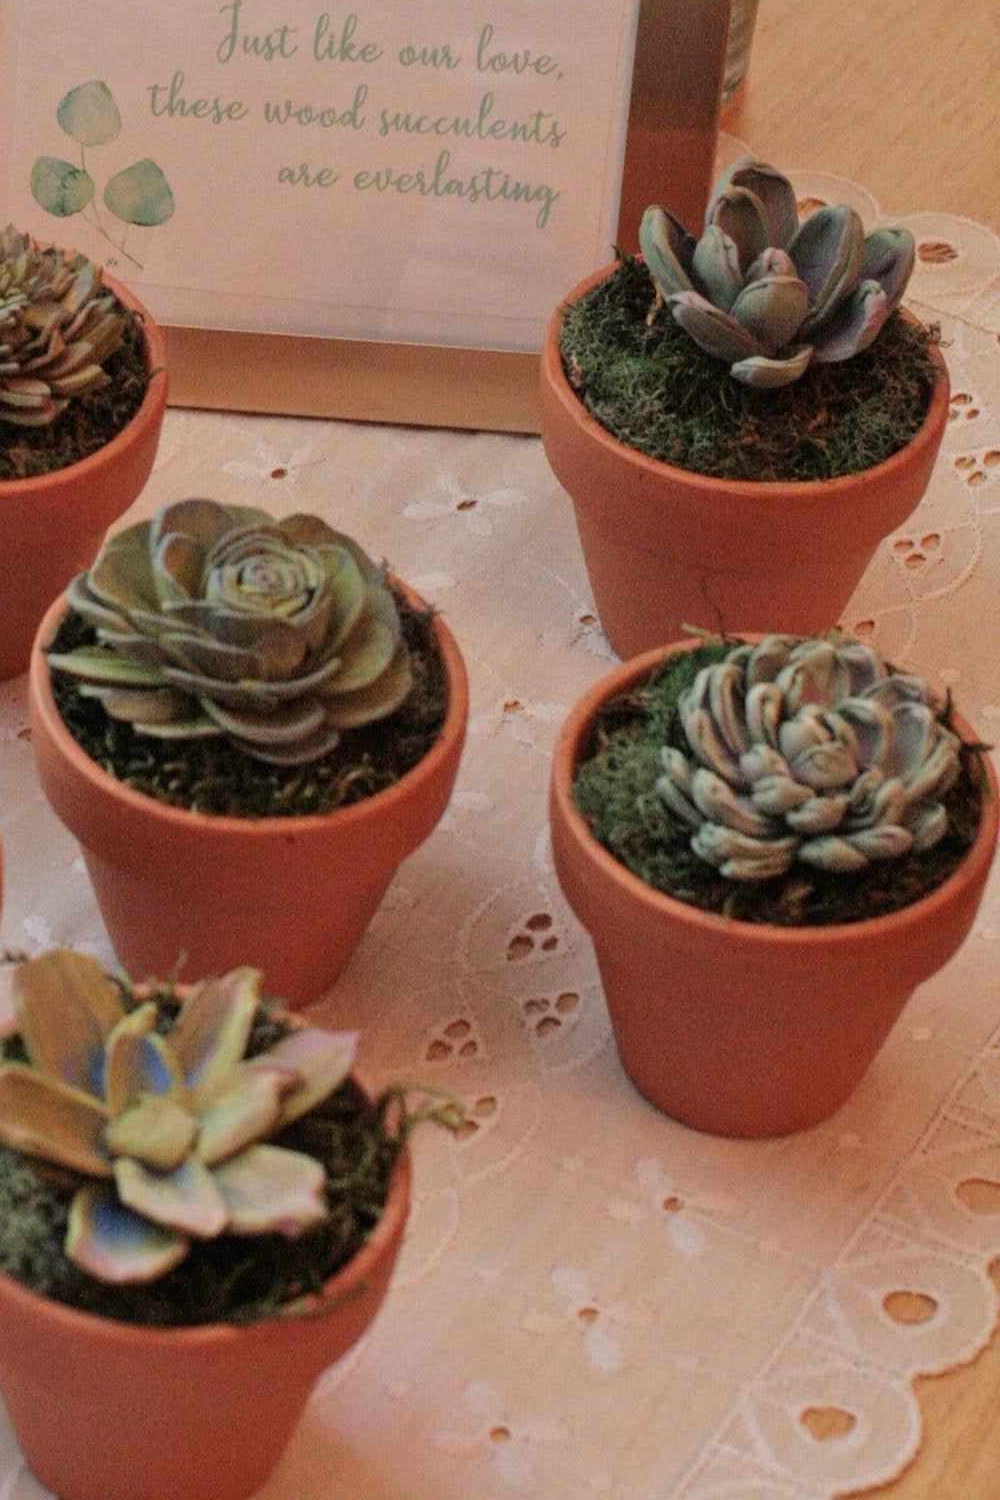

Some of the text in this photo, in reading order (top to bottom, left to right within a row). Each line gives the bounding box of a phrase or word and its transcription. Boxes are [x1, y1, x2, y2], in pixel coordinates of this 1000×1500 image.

[217, 0, 565, 81] Just like our love,
[146, 71, 567, 148] these wood succulents
[277, 150, 560, 229] are everlasting
